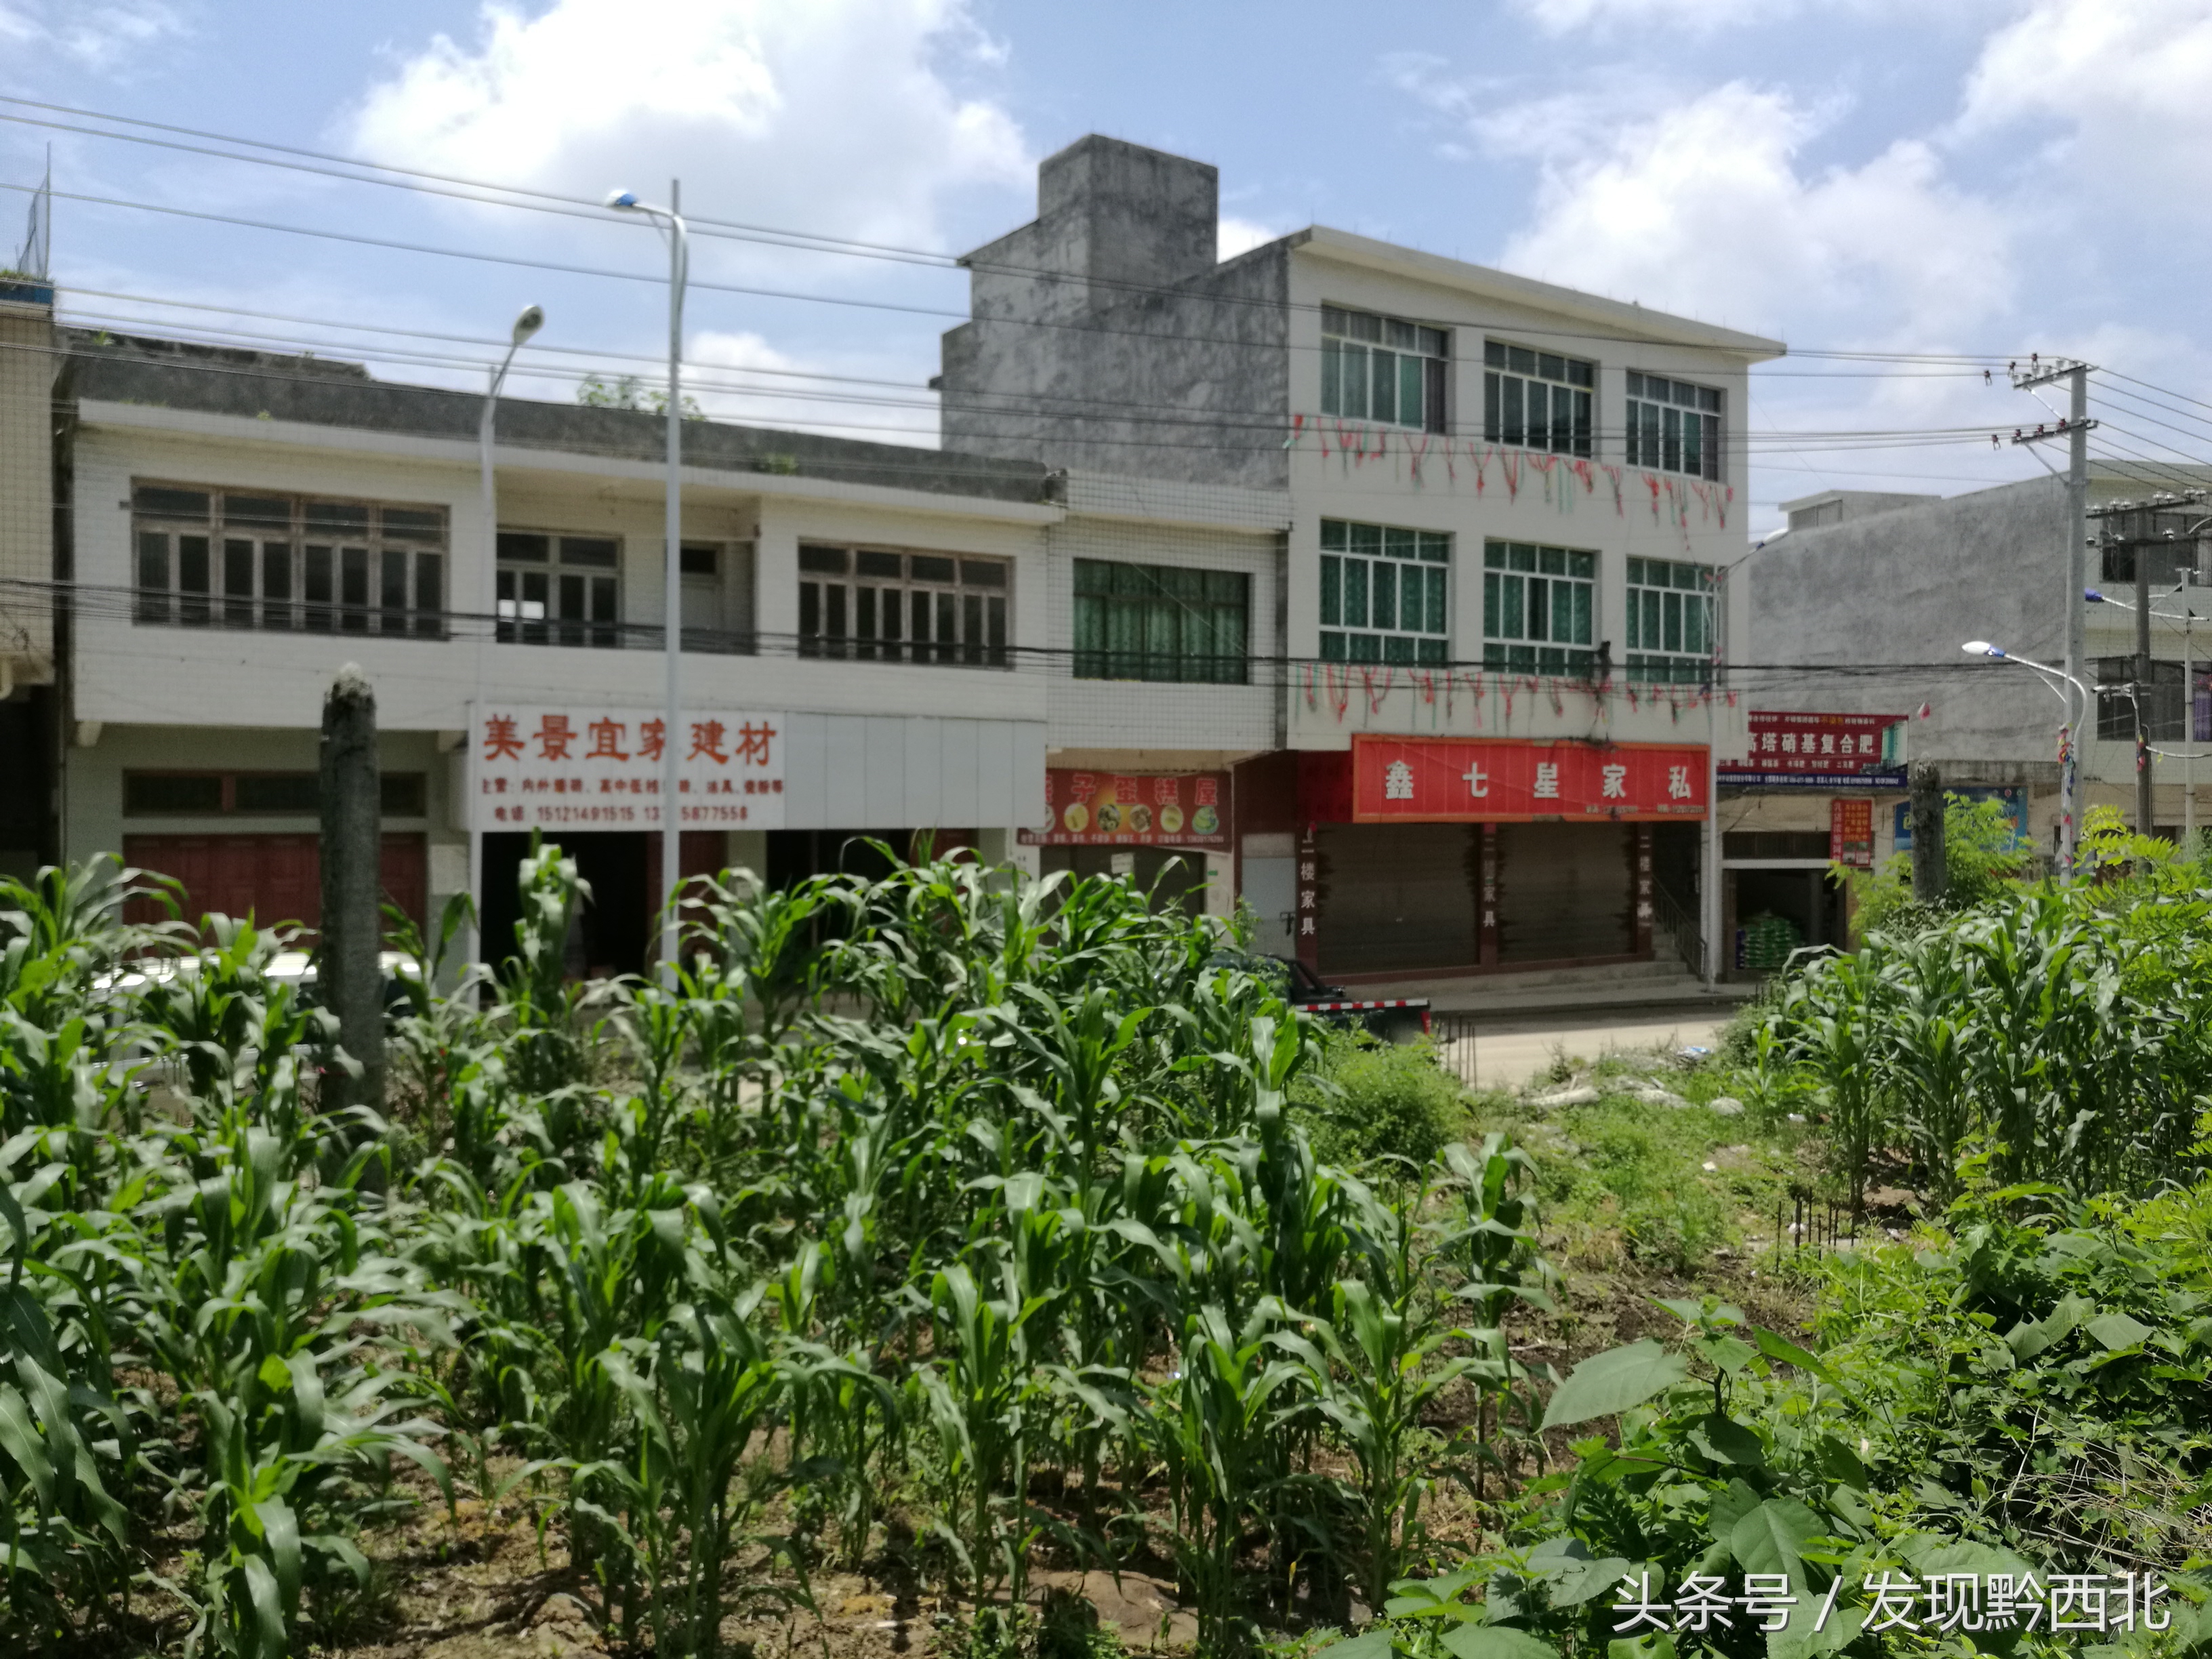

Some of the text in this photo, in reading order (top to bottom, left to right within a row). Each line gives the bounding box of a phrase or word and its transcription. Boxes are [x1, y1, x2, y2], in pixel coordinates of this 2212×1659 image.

[483, 714, 777, 766] 美景宜家建材
[1385, 760, 1692, 800] 鑫七星家私
[644, 806, 748, 822] 135877558
